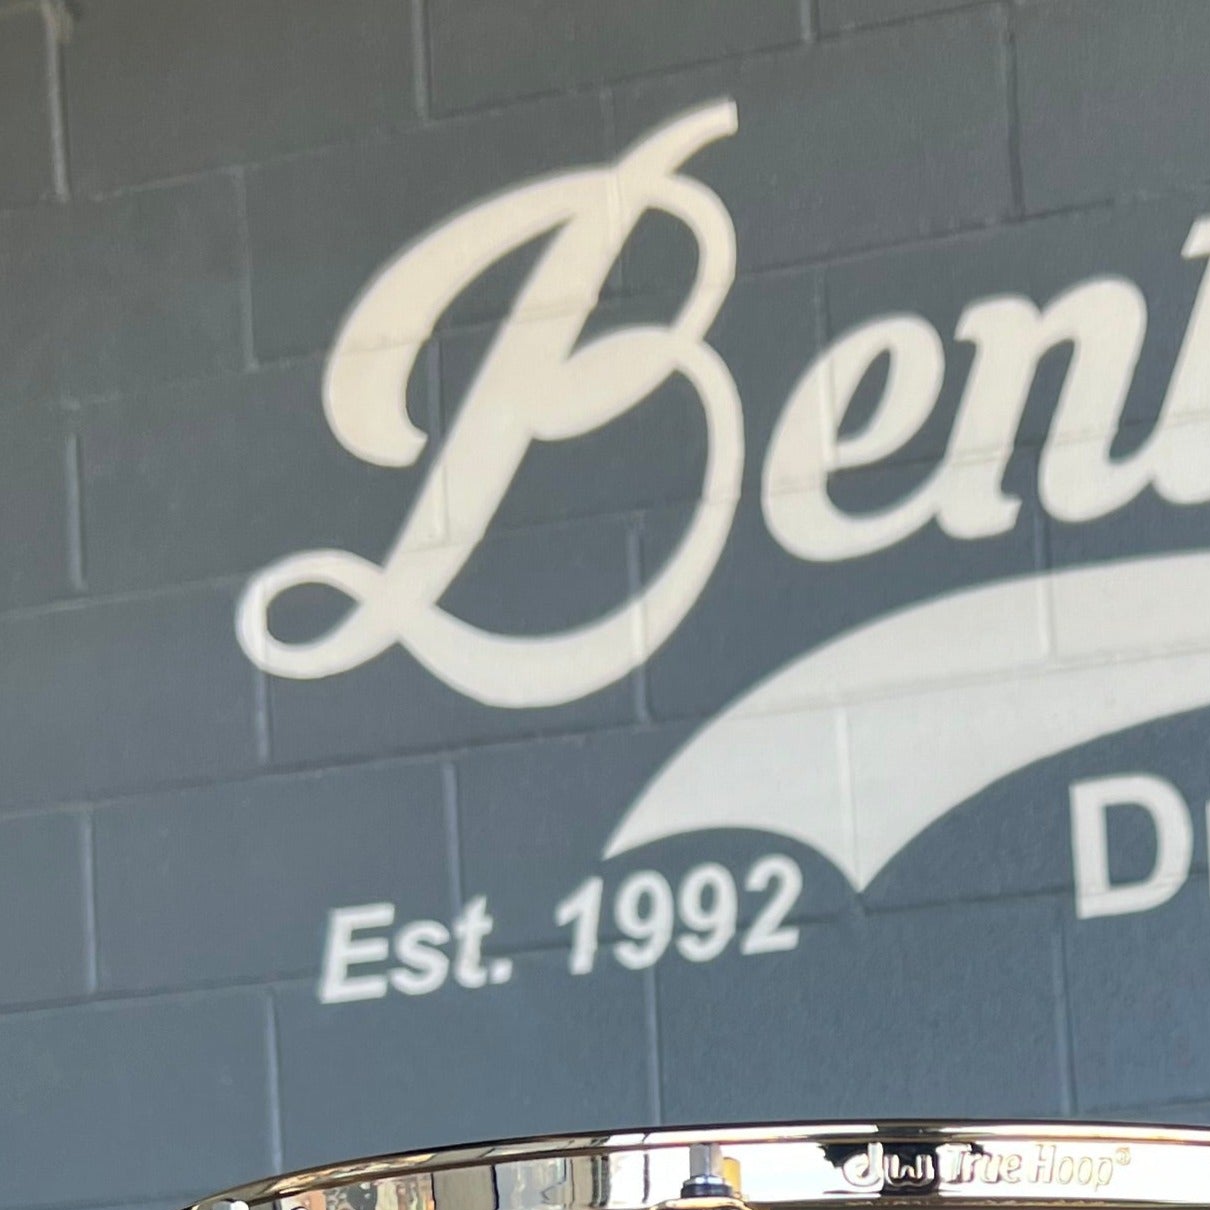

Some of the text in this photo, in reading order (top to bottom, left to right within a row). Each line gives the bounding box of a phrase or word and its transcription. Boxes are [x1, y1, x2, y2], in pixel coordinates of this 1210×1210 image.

[319, 856, 802, 1004] Est. 1992
[938, 1142, 1023, 1184] True
